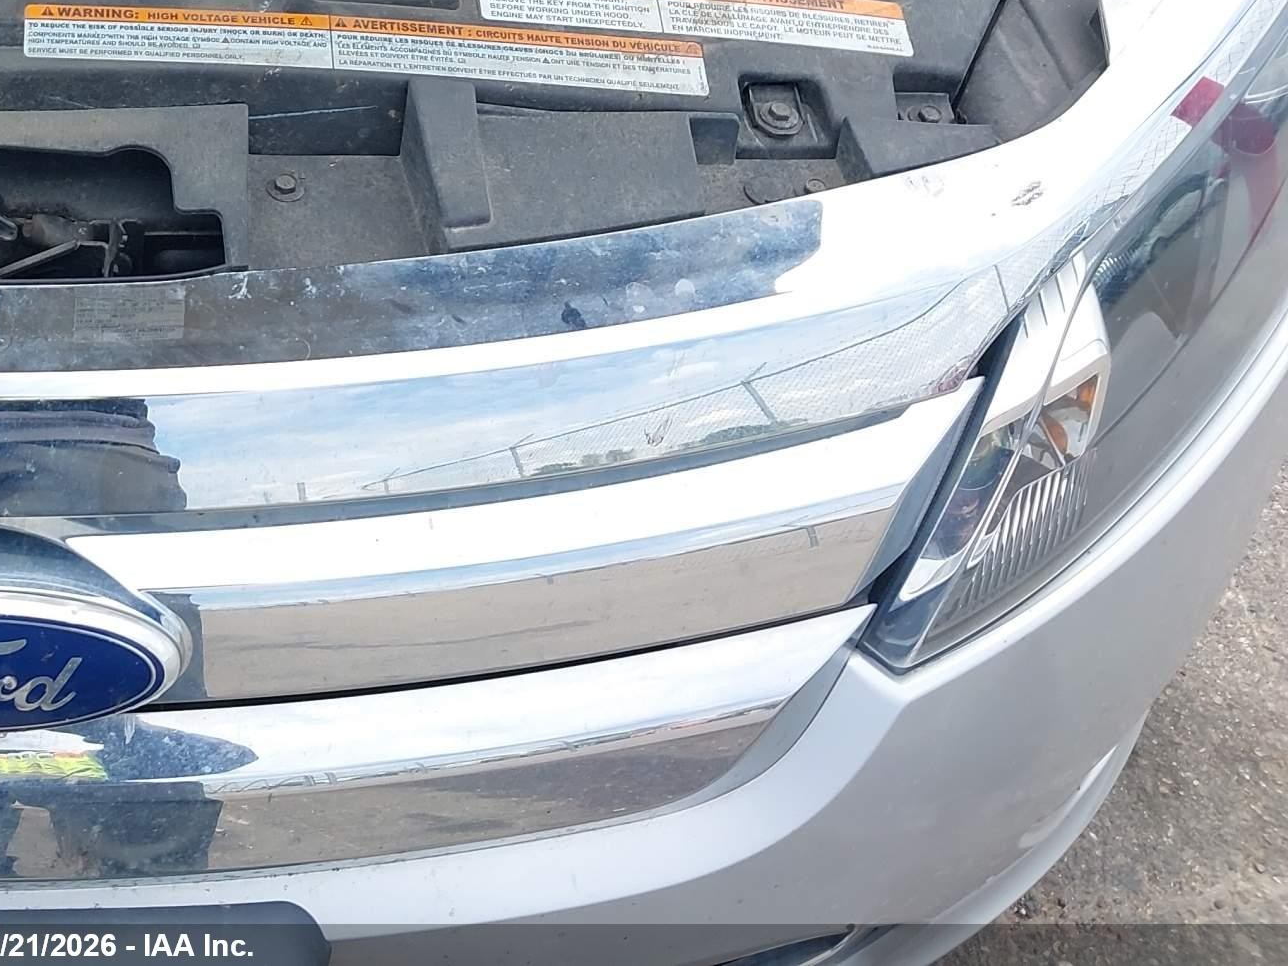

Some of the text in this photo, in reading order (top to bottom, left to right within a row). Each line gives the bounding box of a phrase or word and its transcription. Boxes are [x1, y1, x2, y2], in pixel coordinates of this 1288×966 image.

[490, 3, 525, 11] BEFORE
[528, 6, 568, 15] WORKING
[572, 9, 601, 17] UNDER
[566, 1, 591, 9] FROM
[612, 5, 650, 13] IGNITION
[58, 7, 295, 25] WARNING: HIGH VOLTAGE VEHICLE
[491, 11, 523, 19] ENGINE
[546, 15, 572, 23] START
[352, 19, 463, 36] AVERTISSEMENT
[476, 30, 524, 40] CIRCUITS
[526, 35, 562, 44] HAUTE
[565, 37, 609, 47] TENSION
[612, 40, 627, 48] DU
[630, 40, 681, 53] VÉHICULE
